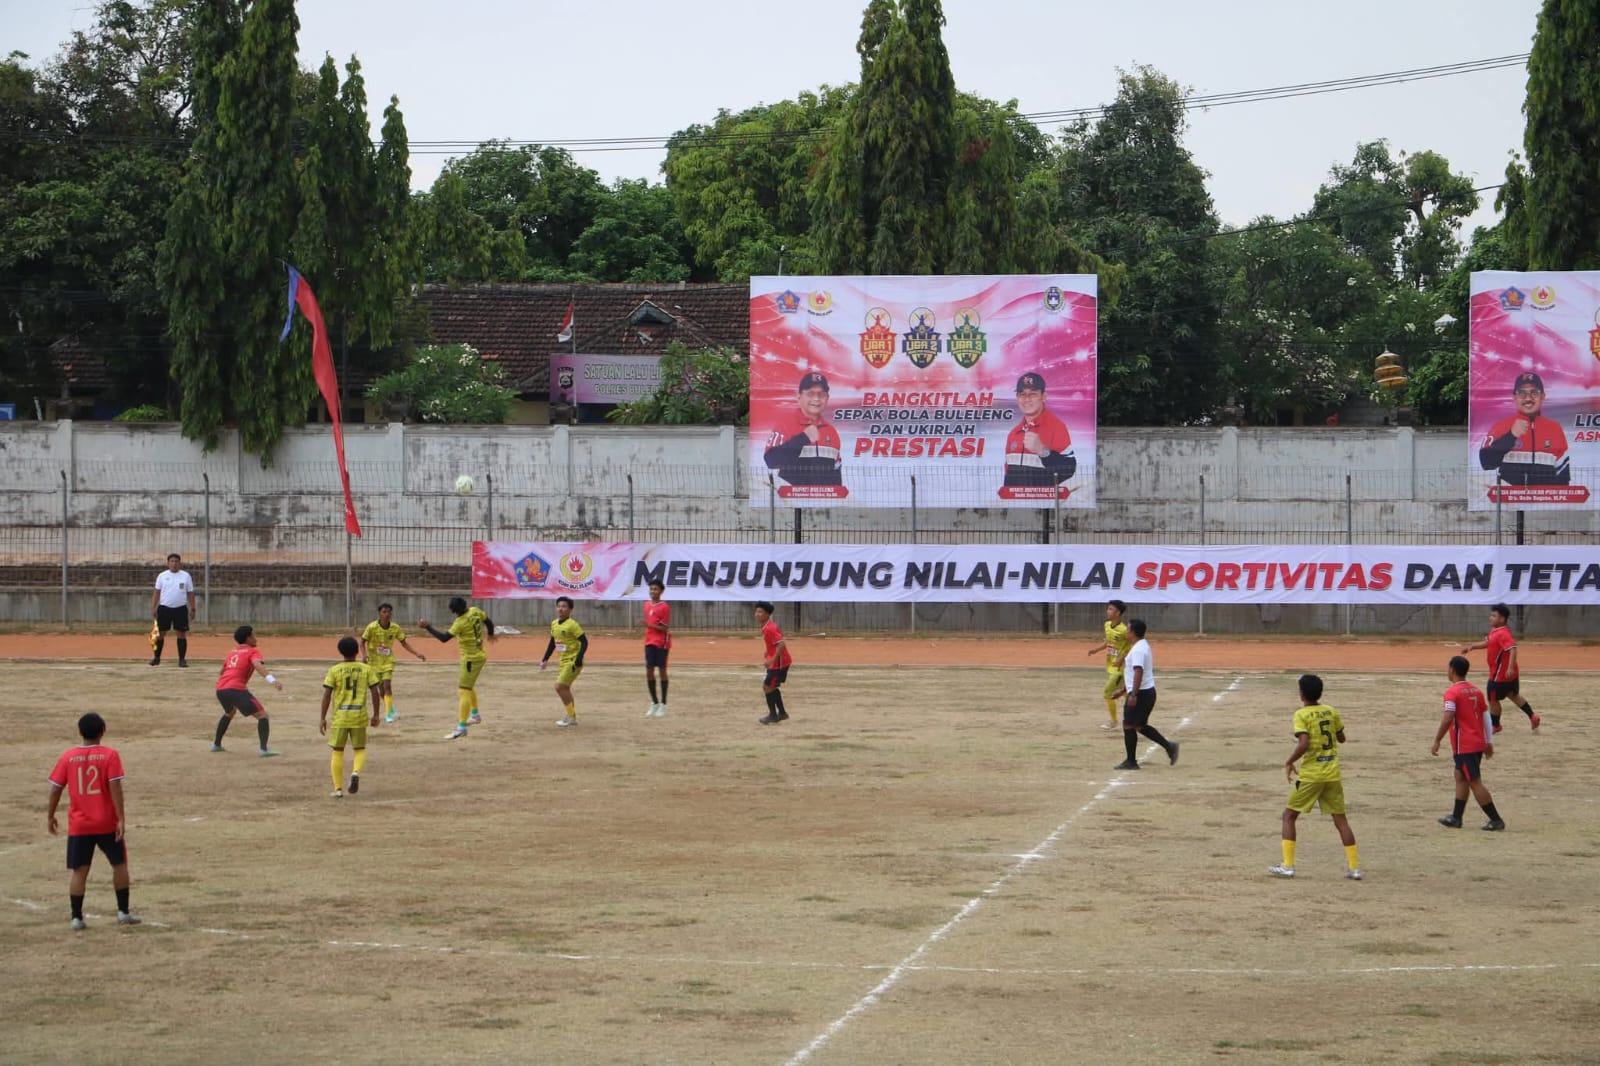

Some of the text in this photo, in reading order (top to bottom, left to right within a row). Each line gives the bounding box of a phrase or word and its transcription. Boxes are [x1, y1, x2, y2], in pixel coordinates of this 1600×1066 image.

[584, 363, 621, 380] SATUAN
[623, 363, 648, 380] LALU
[862, 392, 994, 407] BANGKITLAH
[834, 409, 1013, 421] SEPAK BOLA BULELENG
[870, 424, 976, 436] DAN UKIRLAH
[854, 437, 986, 458] PRESTASI
[633, 560, 1600, 592] MENJUNJUNG NILAI-NILAI SPORTIVITAS DAN TETA
[345, 675, 358, 700] 4
[1319, 720, 1333, 751] 5
[77, 765, 102, 796] 12
